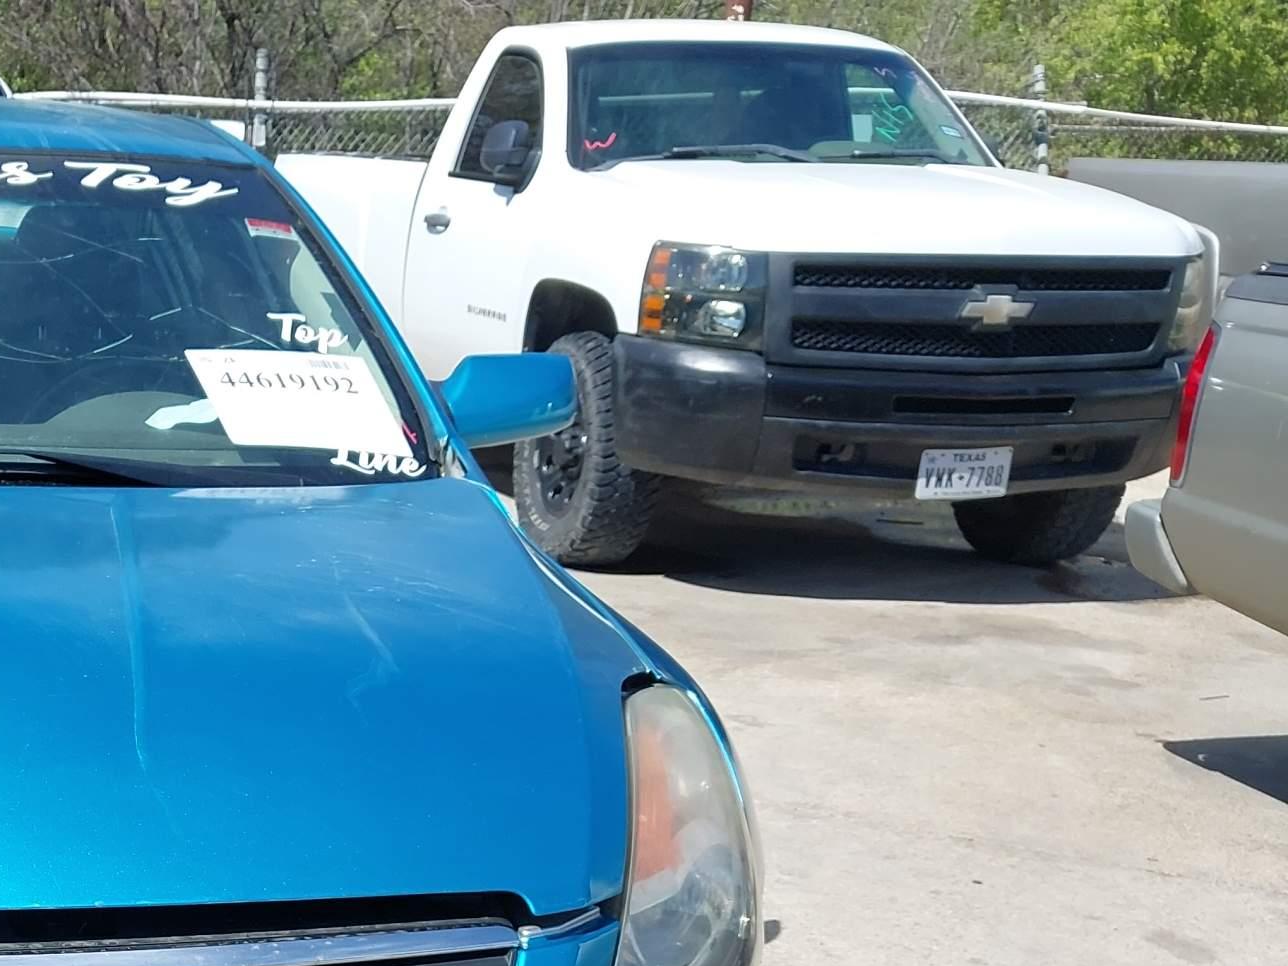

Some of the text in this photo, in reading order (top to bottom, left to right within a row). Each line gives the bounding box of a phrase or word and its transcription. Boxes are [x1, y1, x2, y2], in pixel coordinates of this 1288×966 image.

[63, 160, 239, 207] Toy
[266, 312, 348, 354] Top
[220, 371, 360, 395] 44619192
[330, 448, 427, 478] Line
[953, 452, 987, 463] TEXAS
